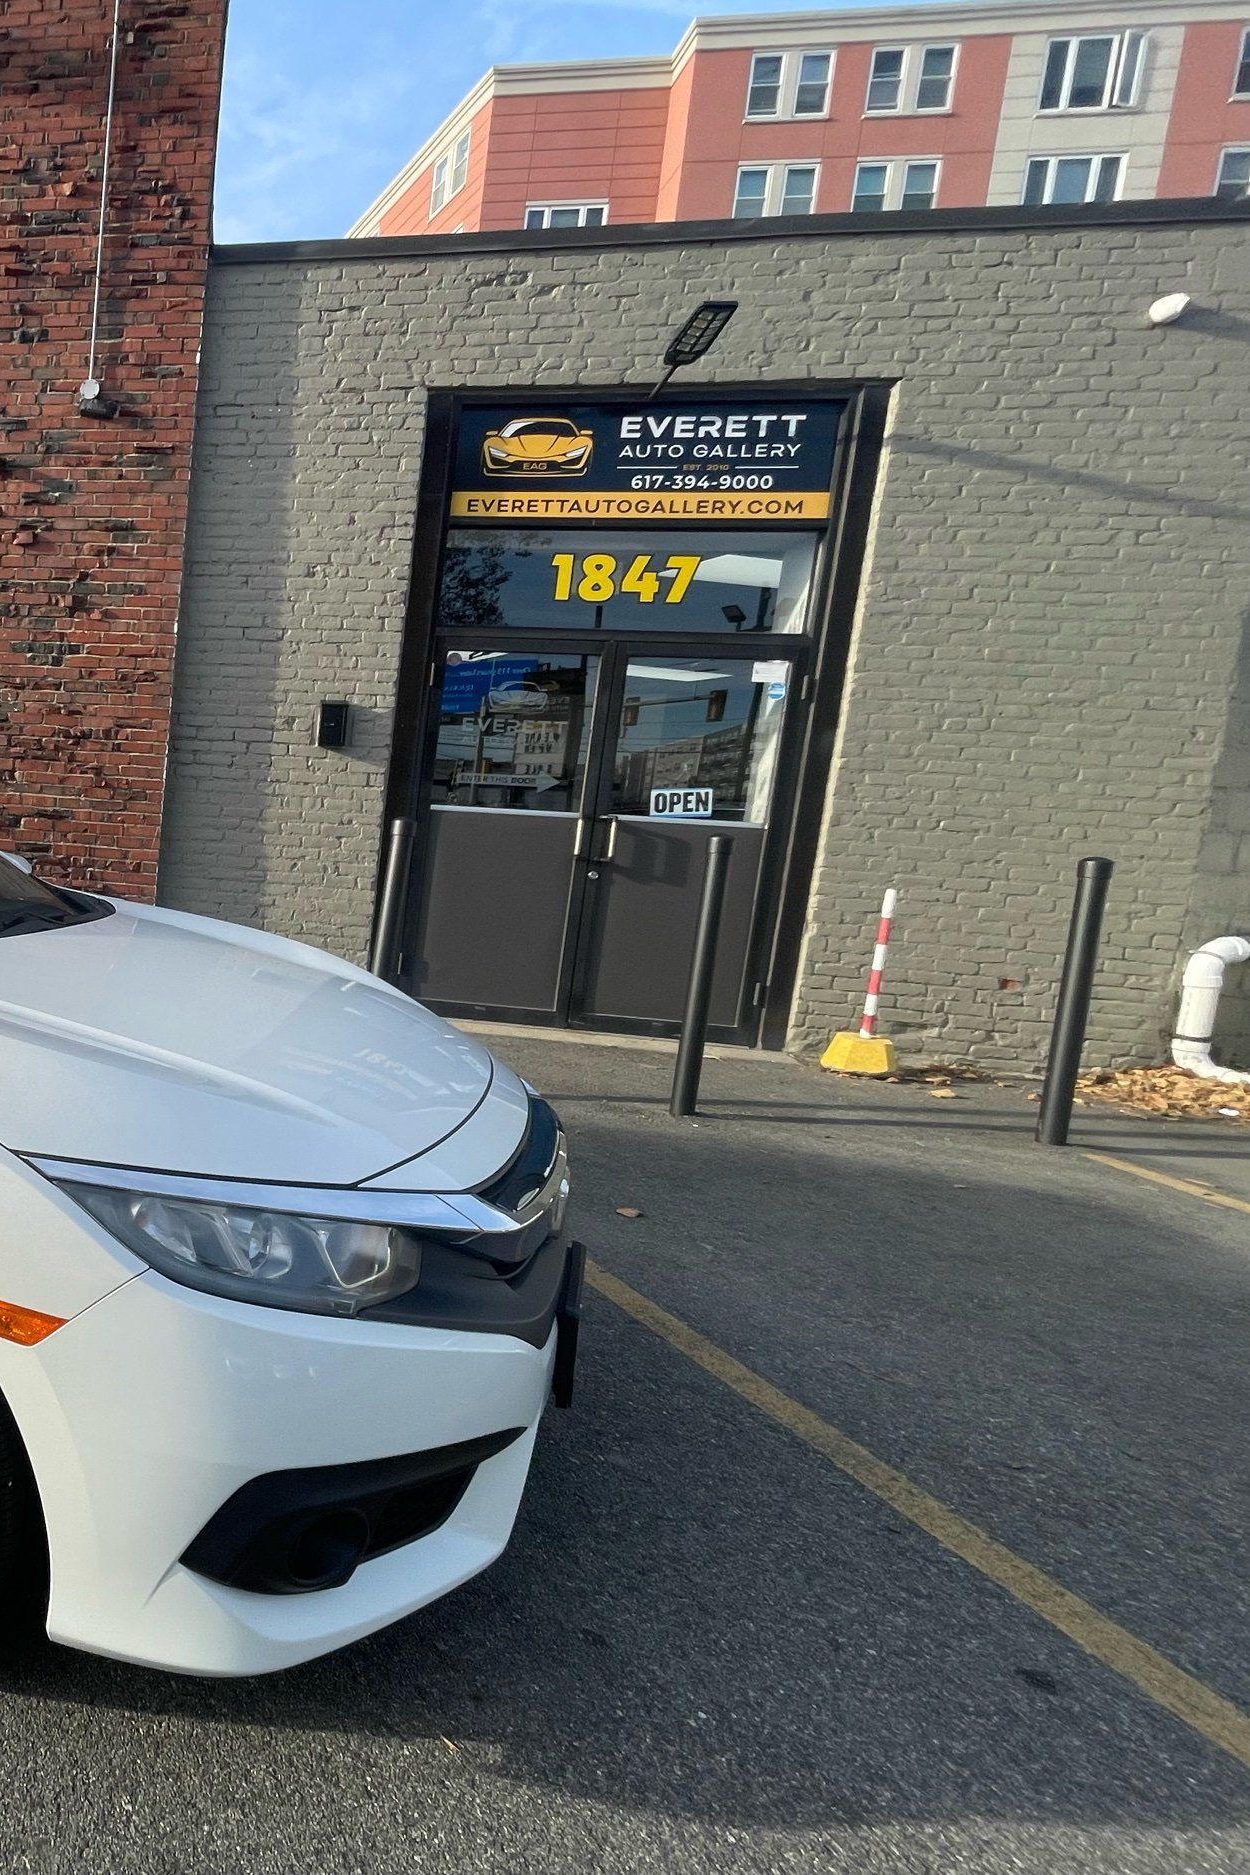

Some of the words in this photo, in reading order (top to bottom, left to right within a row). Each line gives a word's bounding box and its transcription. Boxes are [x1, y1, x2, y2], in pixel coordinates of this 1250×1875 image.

[619, 414, 807, 439] EVERETT
[619, 444, 684, 458] AUTO
[692, 443, 802, 459] GALLERY
[522, 462, 547, 471] EAG
[630, 474, 773, 491] 617-394-9000
[466, 498, 804, 515] EVERETTAUTOGALLERY.COM
[551, 553, 702, 604] 1847
[461, 717, 569, 734] EVERETT
[460, 775, 488, 783] ENTER
[490, 776, 508, 784] THIS
[511, 777, 537, 786] DOOR
[653, 791, 710, 814] OPEN
